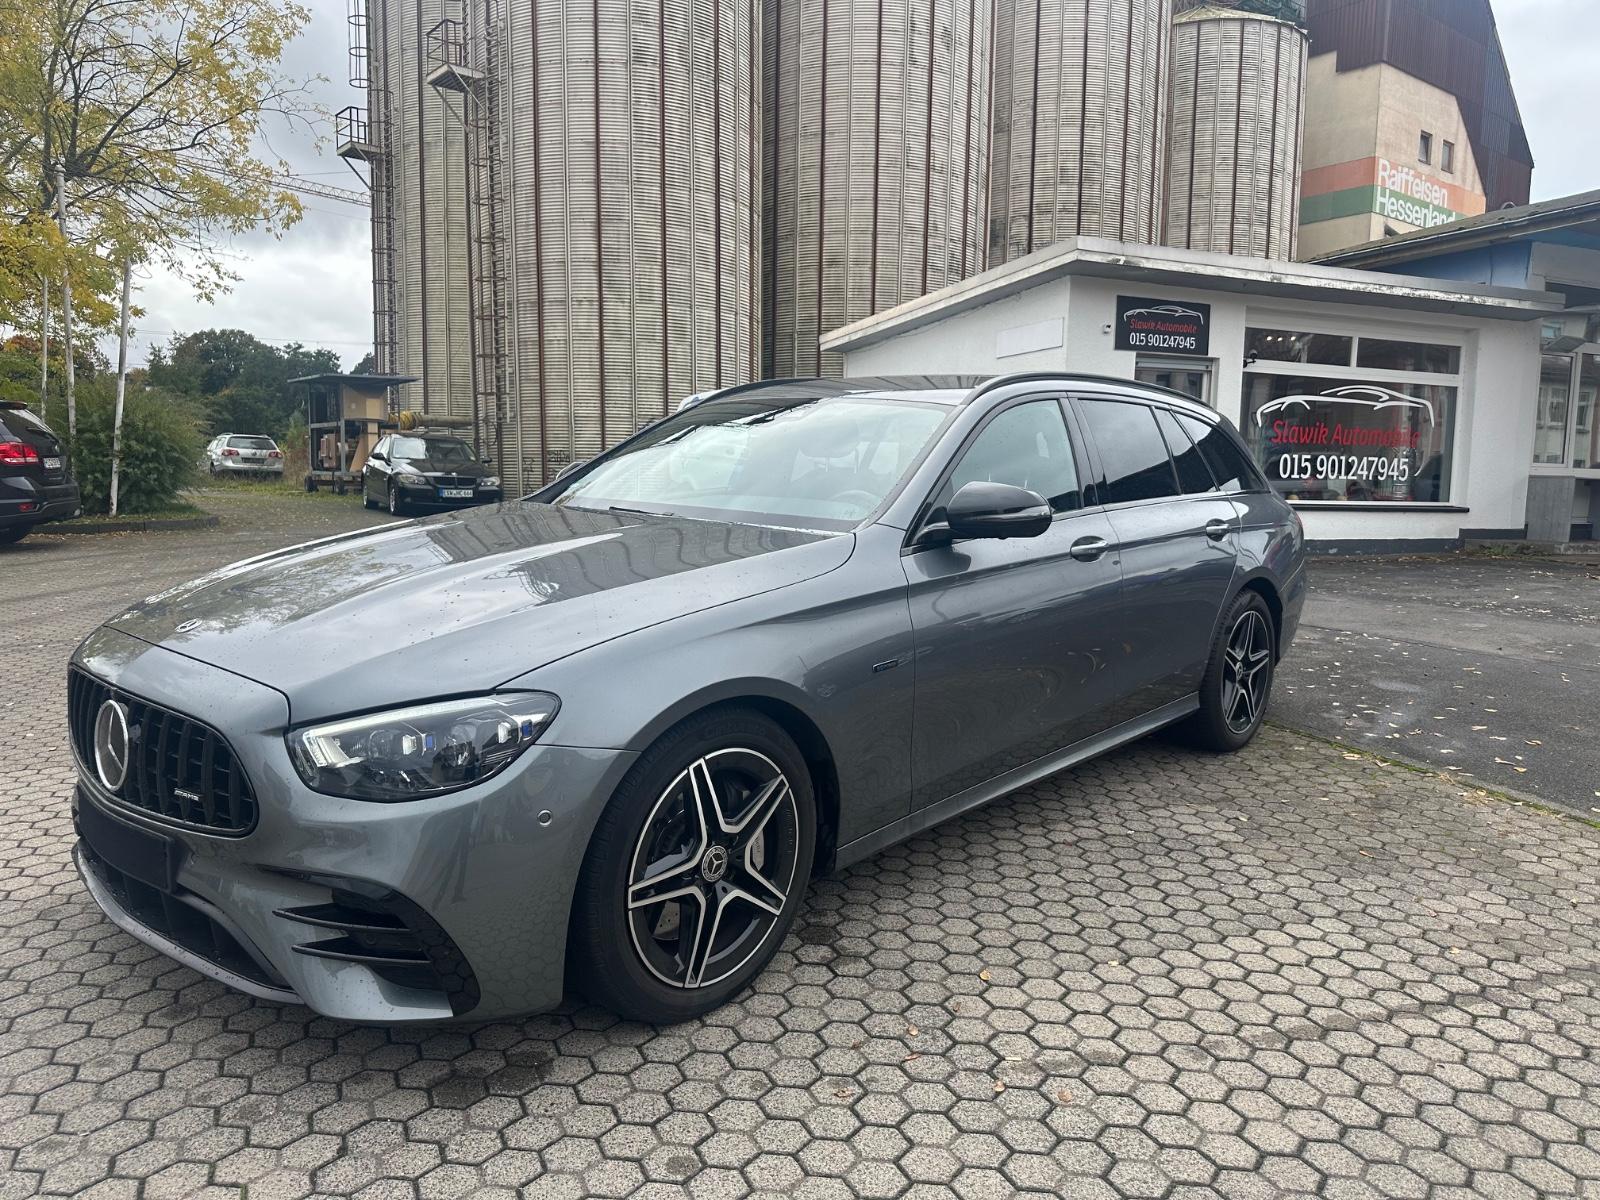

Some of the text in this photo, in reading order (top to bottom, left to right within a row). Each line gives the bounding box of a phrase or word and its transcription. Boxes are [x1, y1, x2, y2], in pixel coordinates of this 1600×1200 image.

[1377, 158, 1448, 209] Raiffeisen
[1129, 332, 1196, 349] 015 901247945
[1155, 321, 1198, 334] Automobile
[1330, 422, 1421, 449] Automobile
[1279, 453, 1409, 481] 015 901247945
